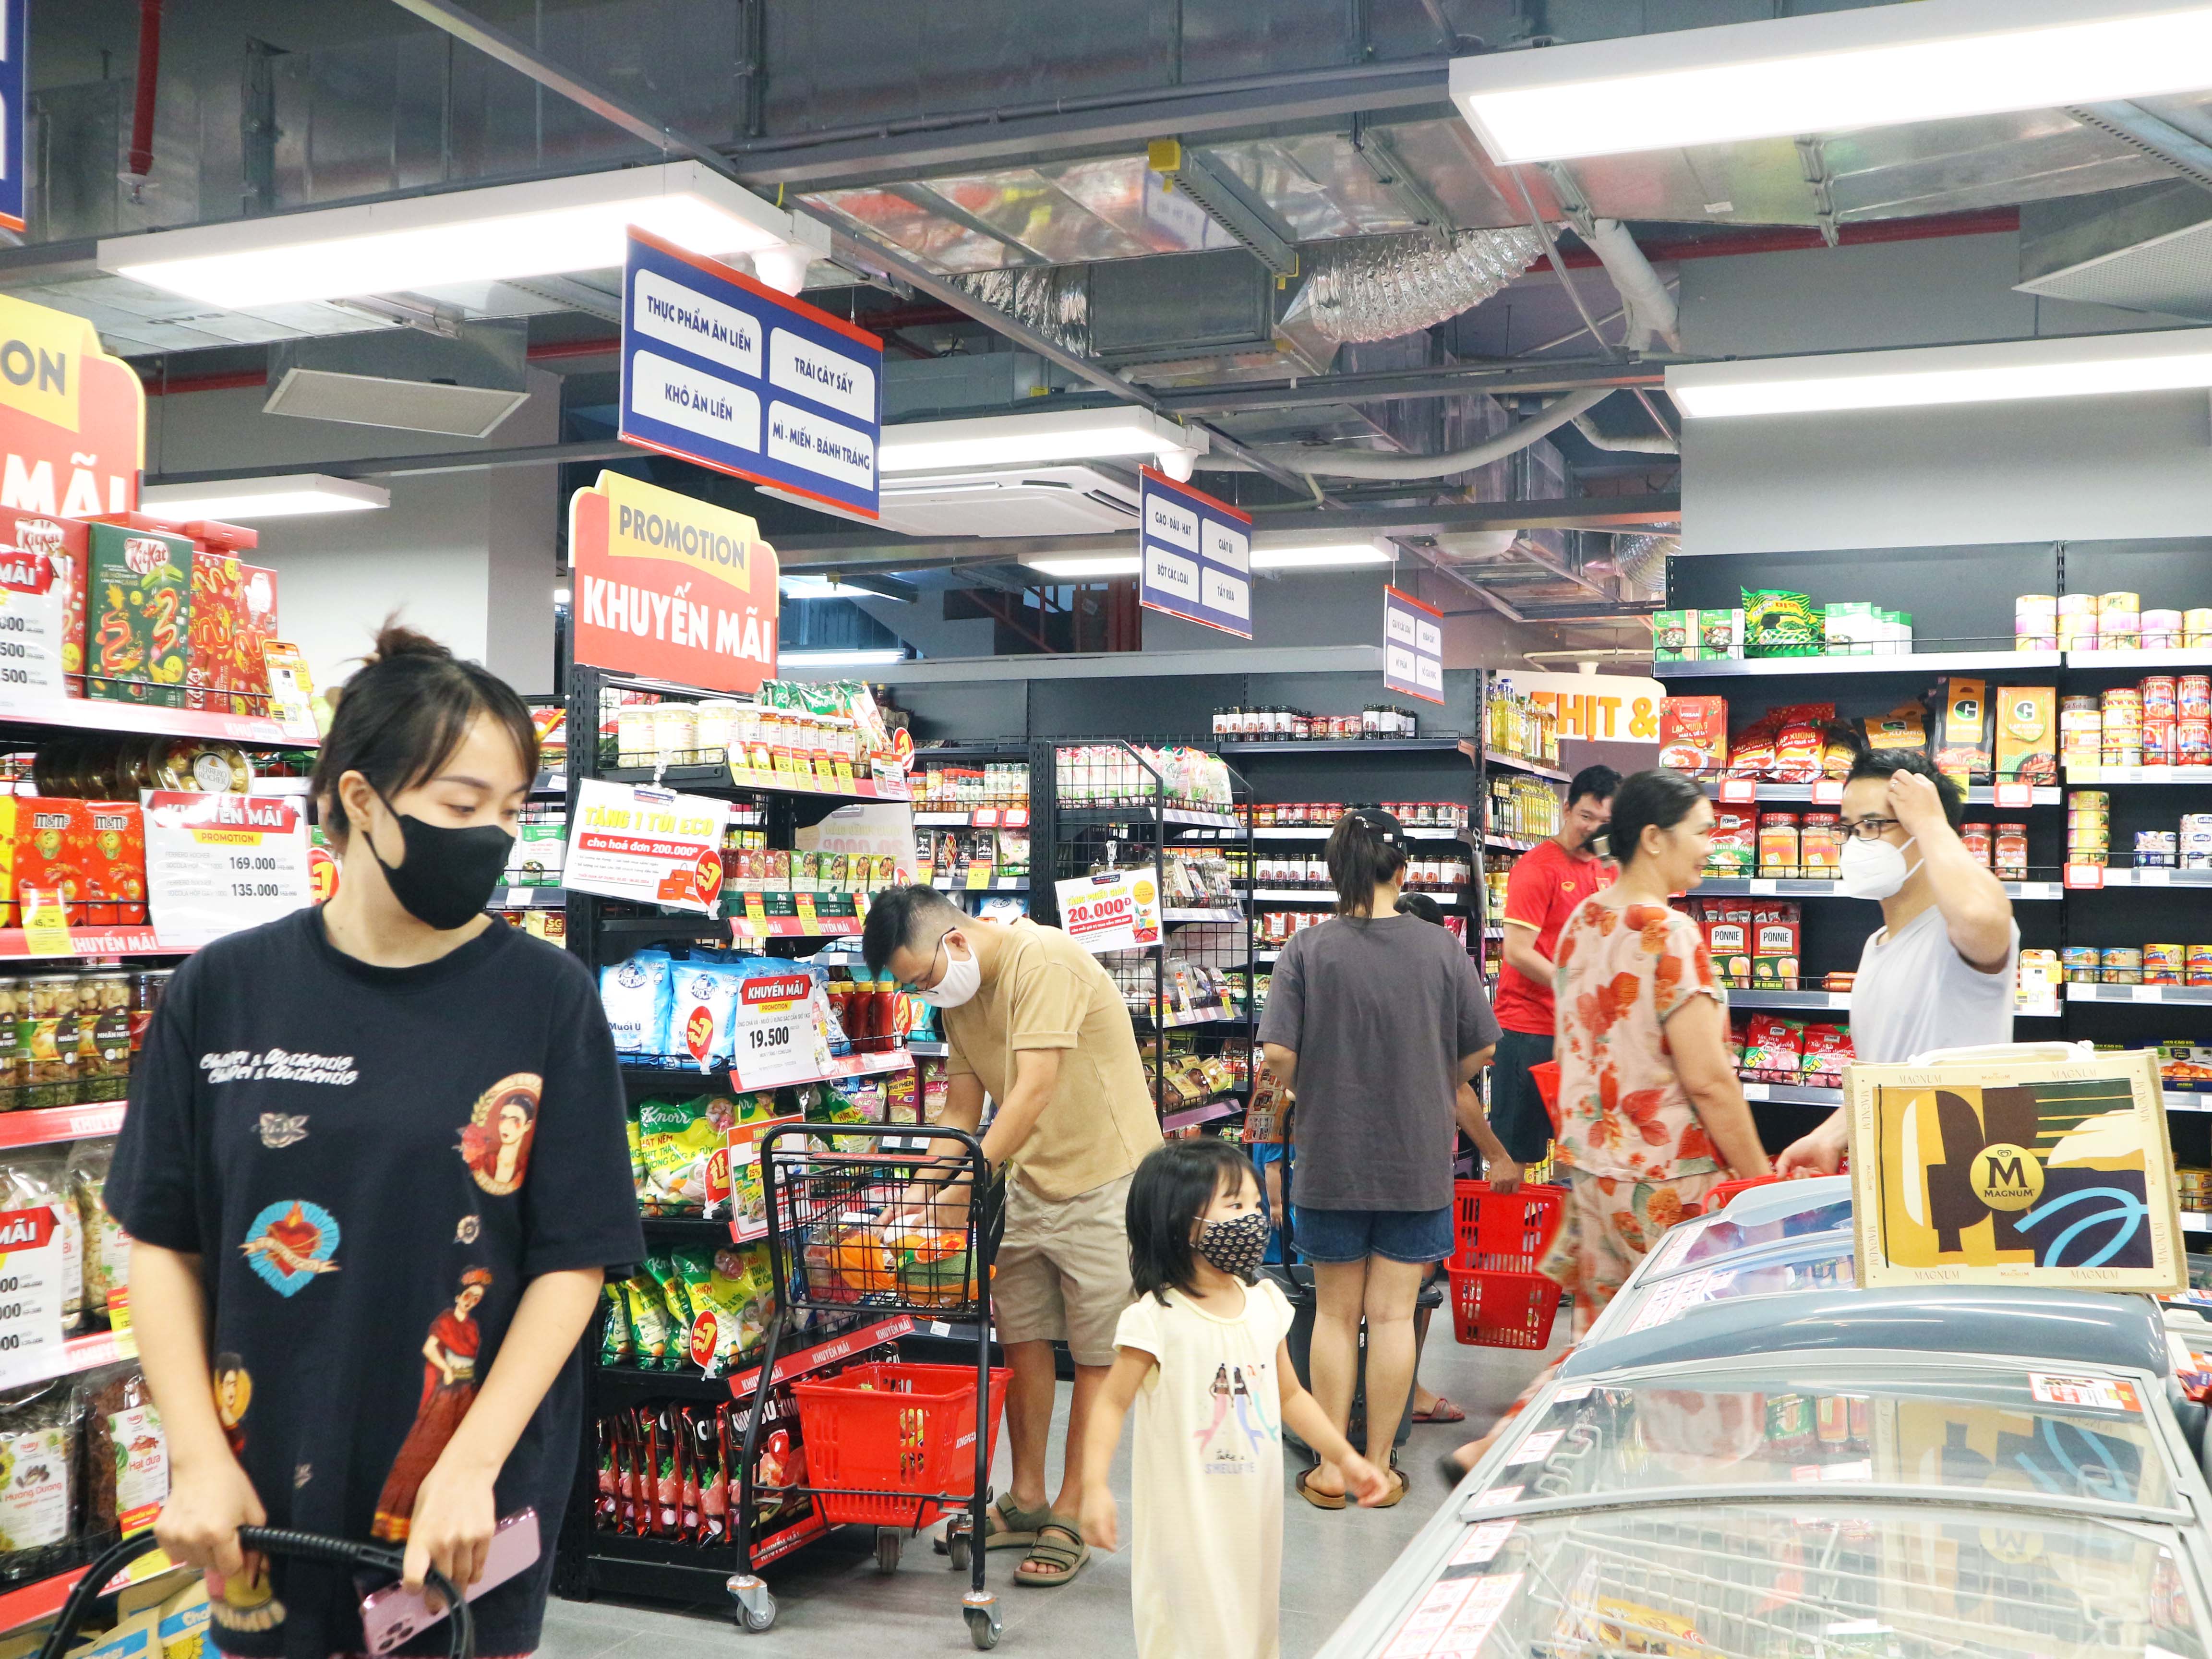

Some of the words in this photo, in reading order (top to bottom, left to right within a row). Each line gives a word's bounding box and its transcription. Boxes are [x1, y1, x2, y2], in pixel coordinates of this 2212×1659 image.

[647, 294, 674, 323] THỰC
[677, 306, 709, 336] PHẨM
[712, 315, 727, 344] ĂN
[730, 327, 751, 353] LIỀN
[794, 353, 815, 379] TRÁI
[817, 363, 835, 386] CÂY
[836, 370, 853, 394] SẤY
[665, 381, 689, 407] KHÔ
[692, 389, 708, 415] ĂN
[711, 396, 733, 421] LIỀN
[773, 419, 783, 440] MÌ
[790, 425, 811, 448] MIẾN
[817, 435, 841, 460] BÁNH
[842, 446, 870, 470] TRÁNG
[1155, 512, 1166, 527] GẠO
[1170, 518, 1179, 533] ĐẬU
[619, 505, 744, 570] PROMOTION
[130, 541, 167, 573] KitKat
[1157, 562, 1167, 579] BỘT
[1168, 567, 1176, 580] CÁC
[1177, 573, 1188, 586] LOẠI
[584, 575, 708, 650] KHUYẾN
[715, 606, 770, 664] MÃI
[1629, 697, 1658, 738] &
[198, 764, 227, 778] FERRERO
[198, 772, 227, 785] ROCHER
[248, 805, 283, 827] MÃI
[585, 804, 630, 833] TẶNG
[634, 811, 643, 830] 1
[648, 809, 676, 833] TÚI
[679, 817, 714, 836] ECO
[202, 832, 254, 843] PROMOTION
[587, 838, 607, 848] cho
[608, 839, 628, 850] hoá
[630, 841, 650, 852] đơn
[229, 856, 276, 870] 169.000
[231, 883, 278, 897] 135.000
[1066, 895, 1085, 907] TẶNG
[1086, 889, 1107, 902] PHIẾU
[1110, 885, 1128, 898] GIẢM
[547, 918, 562, 927] SG
[127, 932, 157, 950] MÃI
[748, 981, 784, 999] KHUYẾN
[786, 980, 803, 996] MÃI
[749, 1026, 789, 1049] 19.500
[1899, 1075, 1942, 1084] MAGNUM
[2051, 1068, 2097, 1079] MAGNUM
[1861, 1090, 1870, 1130] MAGNUM
[2141, 1081, 2150, 1123] MAGNUM
[644, 1106, 691, 1124] Knorr
[658, 1134, 673, 1146] NÊM
[648, 1157, 668, 1169] ƯƠNG
[749, 1168, 760, 1177] 25%
[1986, 1156, 2026, 1188] M
[1984, 1189, 2033, 1198] MAGNUM
[1869, 1225, 1878, 1267] MAGNUM
[1914, 1270, 1960, 1280] MAGNUM
[2070, 1270, 2119, 1280] MAGNUM
[876, 1322, 898, 1340] KHUYẾN
[898, 1318, 910, 1333] MÃI
[812, 1345, 837, 1364] KHUYẾN
[837, 1342, 850, 1358] MÃI
[741, 1368, 761, 1391] KHUY
[955, 1431, 976, 1449] KINGFOO
